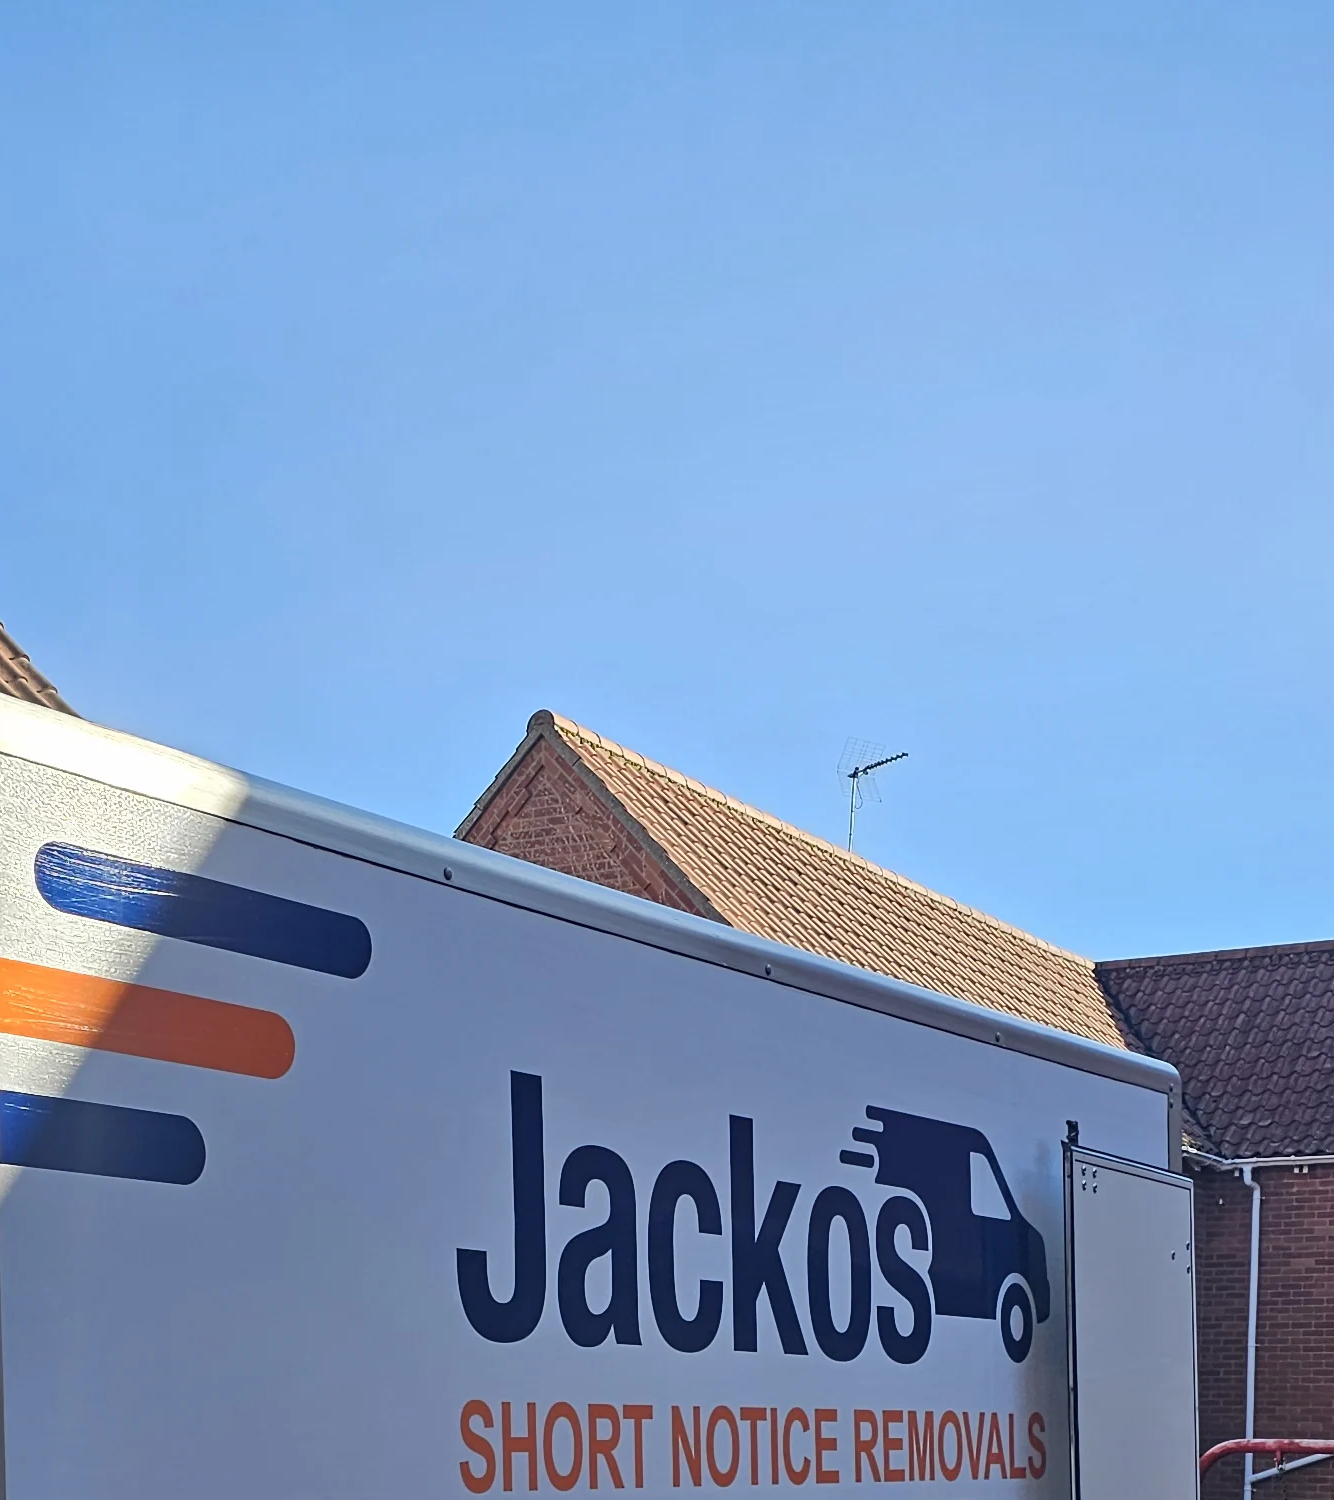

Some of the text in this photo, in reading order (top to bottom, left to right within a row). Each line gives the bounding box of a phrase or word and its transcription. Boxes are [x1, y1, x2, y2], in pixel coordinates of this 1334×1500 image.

[456, 1069, 933, 1365] Jackos
[458, 1399, 1048, 1494] SHORT NOTICE REMOVALS
